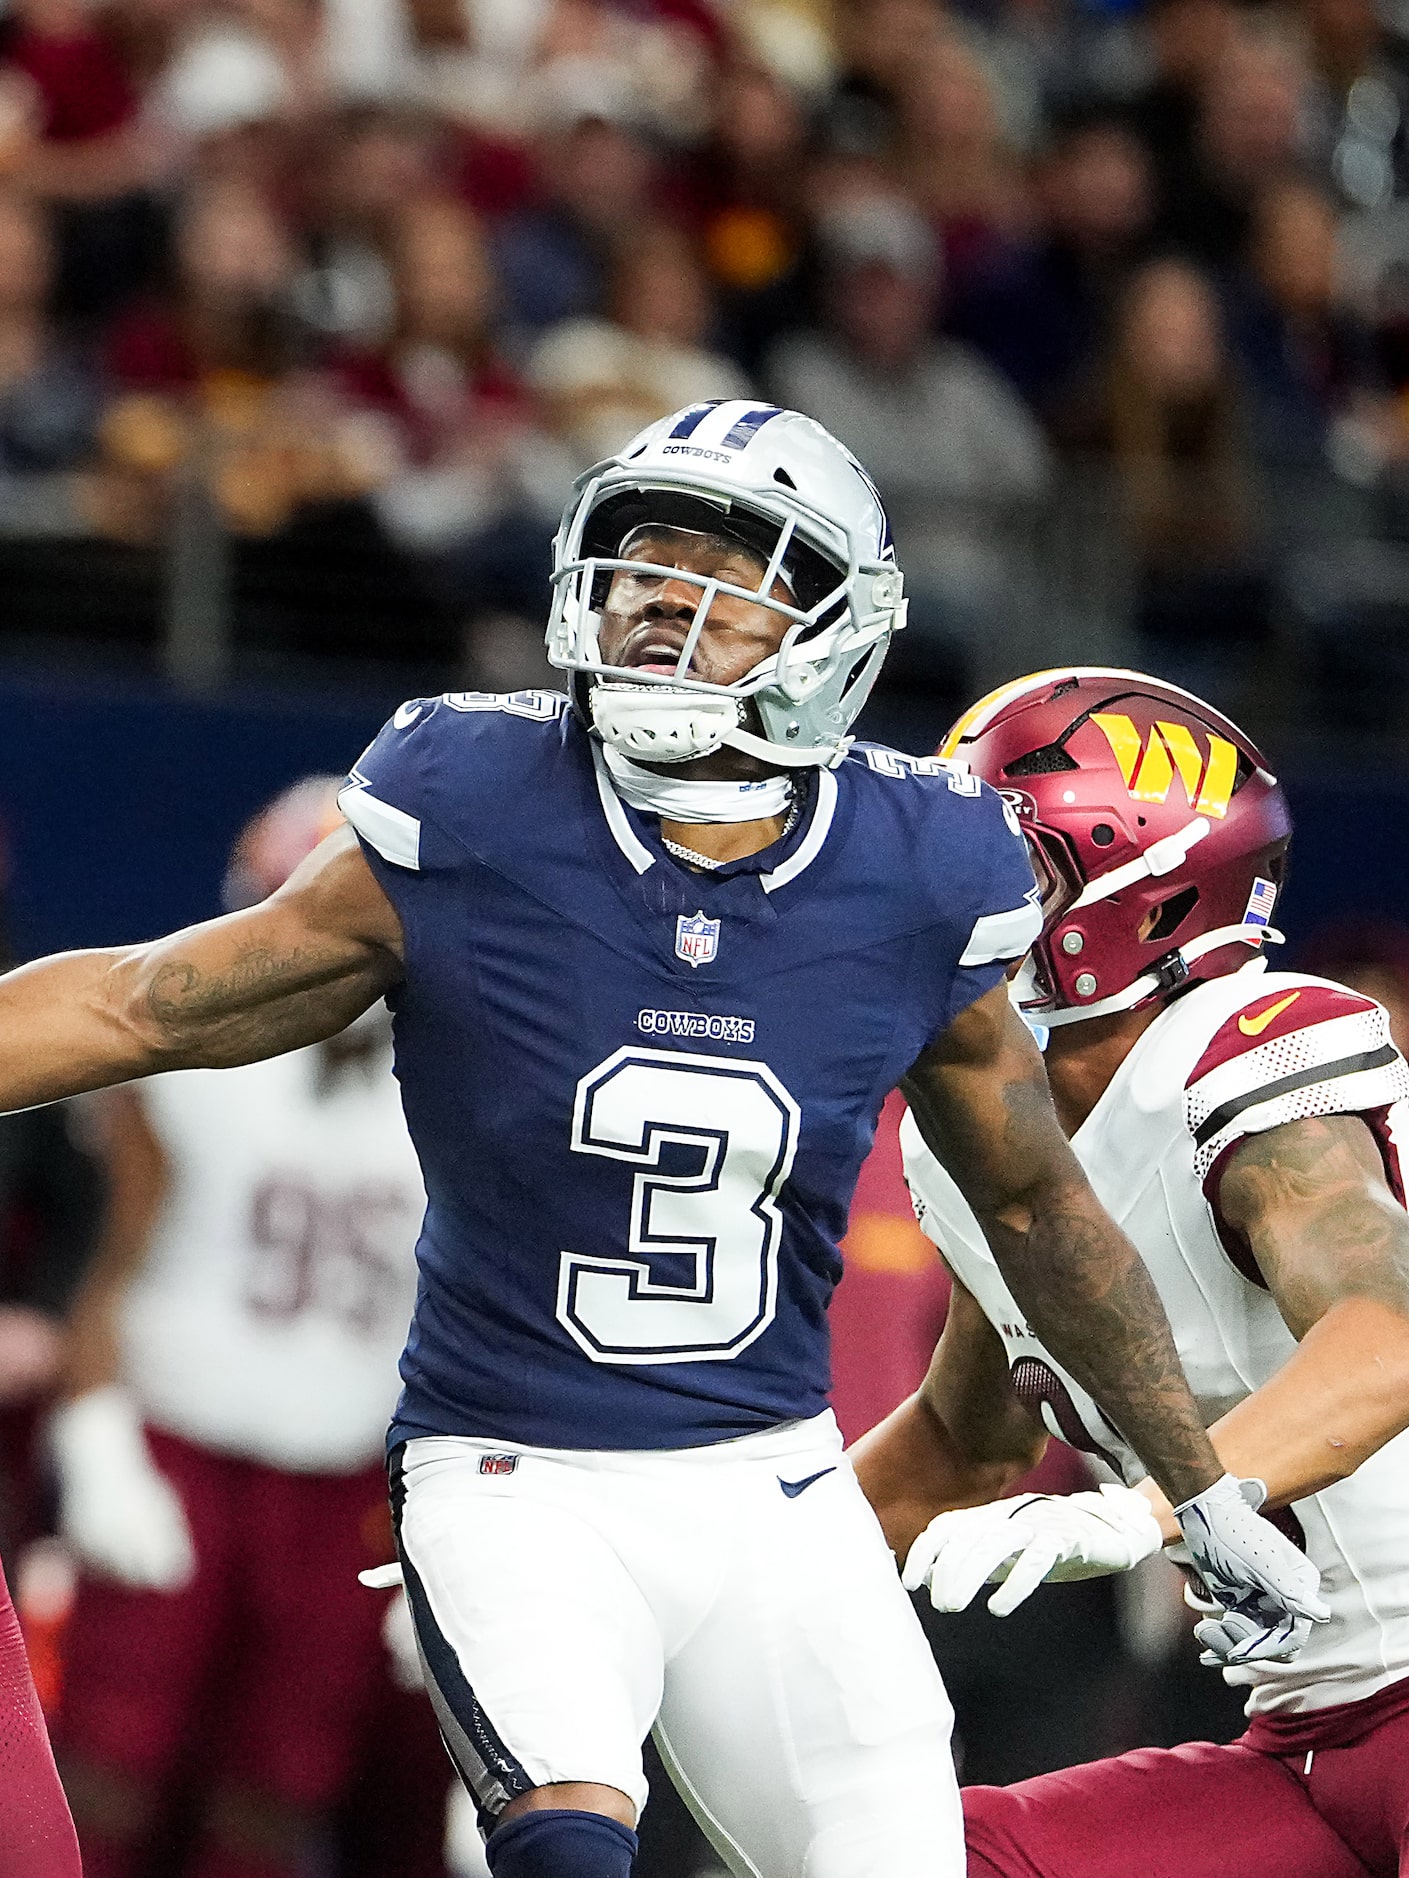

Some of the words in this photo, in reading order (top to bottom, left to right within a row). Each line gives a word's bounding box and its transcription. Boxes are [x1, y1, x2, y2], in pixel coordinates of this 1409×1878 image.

[662, 446, 732, 464] COWBOYS
[1089, 713, 1238, 819] W
[682, 936, 710, 957] NFL
[638, 1009, 755, 1043] COWBOYS
[555, 1045, 802, 1365] 3
[483, 1460, 512, 1474] NFL
